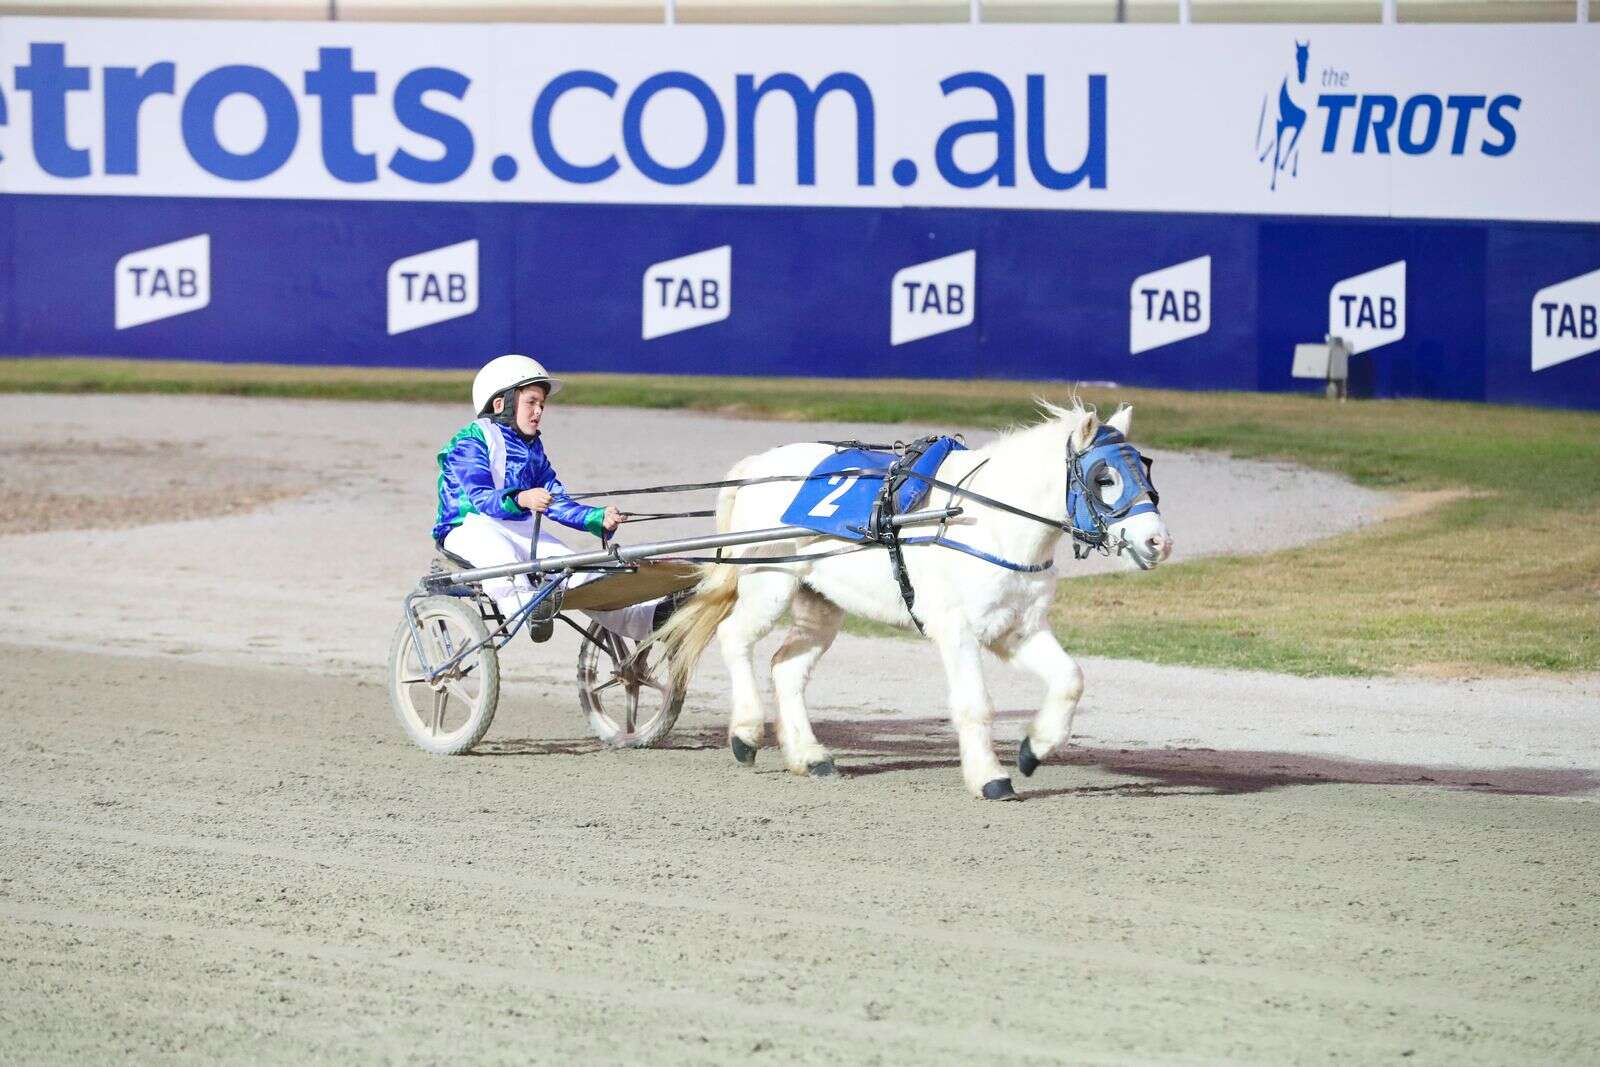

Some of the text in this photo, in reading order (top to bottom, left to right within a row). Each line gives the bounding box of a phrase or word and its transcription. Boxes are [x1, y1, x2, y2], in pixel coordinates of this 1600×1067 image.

[1321, 67, 1350, 87] the
[0, 42, 1108, 190] trots.com.au
[1316, 94, 1523, 157] TROTS
[128, 267, 197, 298] TAB
[400, 272, 468, 303] TAB
[655, 277, 720, 309] TAB
[903, 281, 965, 315] TAB
[1140, 289, 1202, 322] TAB
[1339, 295, 1397, 330] TAB
[1541, 302, 1598, 339] TAB
[808, 467, 860, 517] 2
